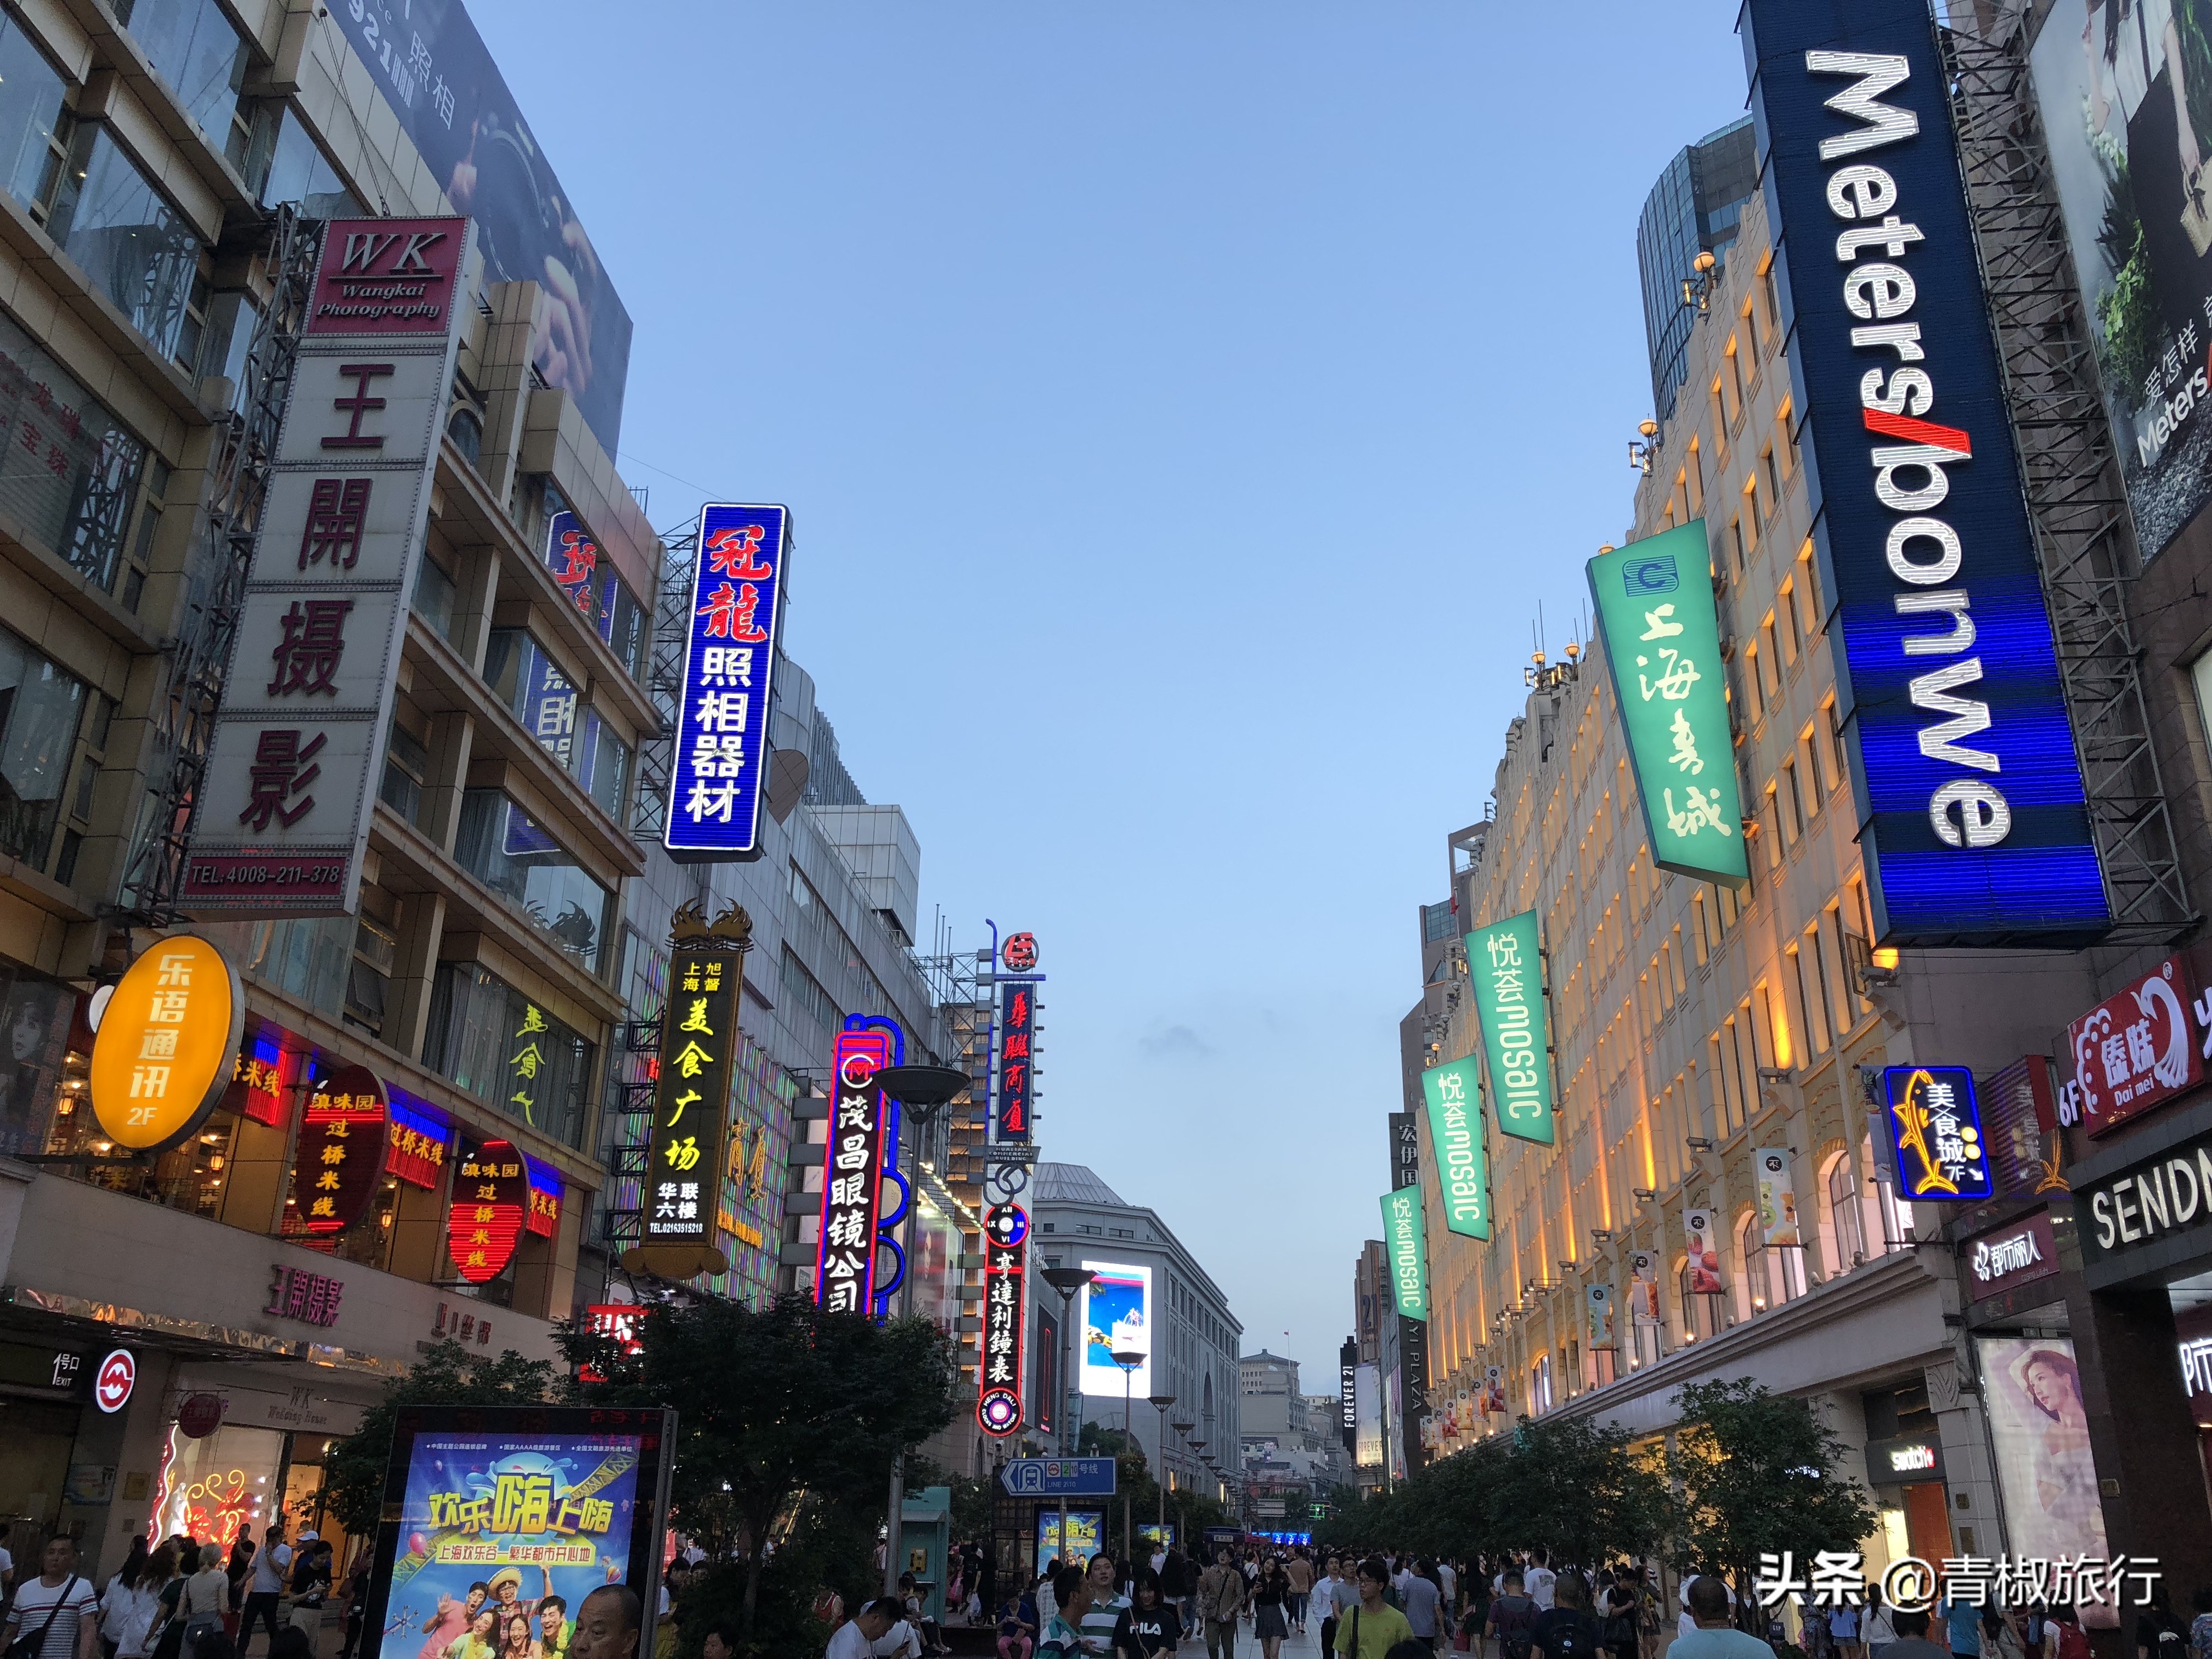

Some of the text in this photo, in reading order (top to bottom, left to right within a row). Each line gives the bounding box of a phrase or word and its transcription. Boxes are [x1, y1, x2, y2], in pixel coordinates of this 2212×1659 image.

[341, 233, 447, 275] WK
[317, 301, 441, 320] Photography
[342, 283, 426, 300] Wangkai
[2145, 318, 2198, 411] 爱怎样
[129, 955, 195, 1098] 乐语通讯
[665, 997, 714, 1171] 美食广场
[2059, 1079, 2080, 1127] 6F
[2114, 1073, 2155, 1107] Dai mei
[127, 1107, 158, 1126] 2F
[1926, 1084, 1967, 1164] 美食城
[310, 1118, 350, 1217] 过桥米线
[1399, 1124, 1419, 1187] 宏伊国
[656, 1201, 698, 1219] 六楼
[658, 1182, 699, 1200] 华联
[824, 1094, 873, 1314] 茂昌眼镜公司
[467, 1184, 498, 1267] 过桥米线
[1990, 1231, 2042, 1278] 都市丽人
[56, 1376, 72, 1387] EXIT
[983, 1392, 1017, 1407] HENG DALI
[1342, 1365, 1355, 1427] FOREVER 21
[1410, 1352, 1422, 1410] PLAZA
[1079, 1463, 1098, 1475] 号线
[1129, 1621, 1161, 1635] FILA
